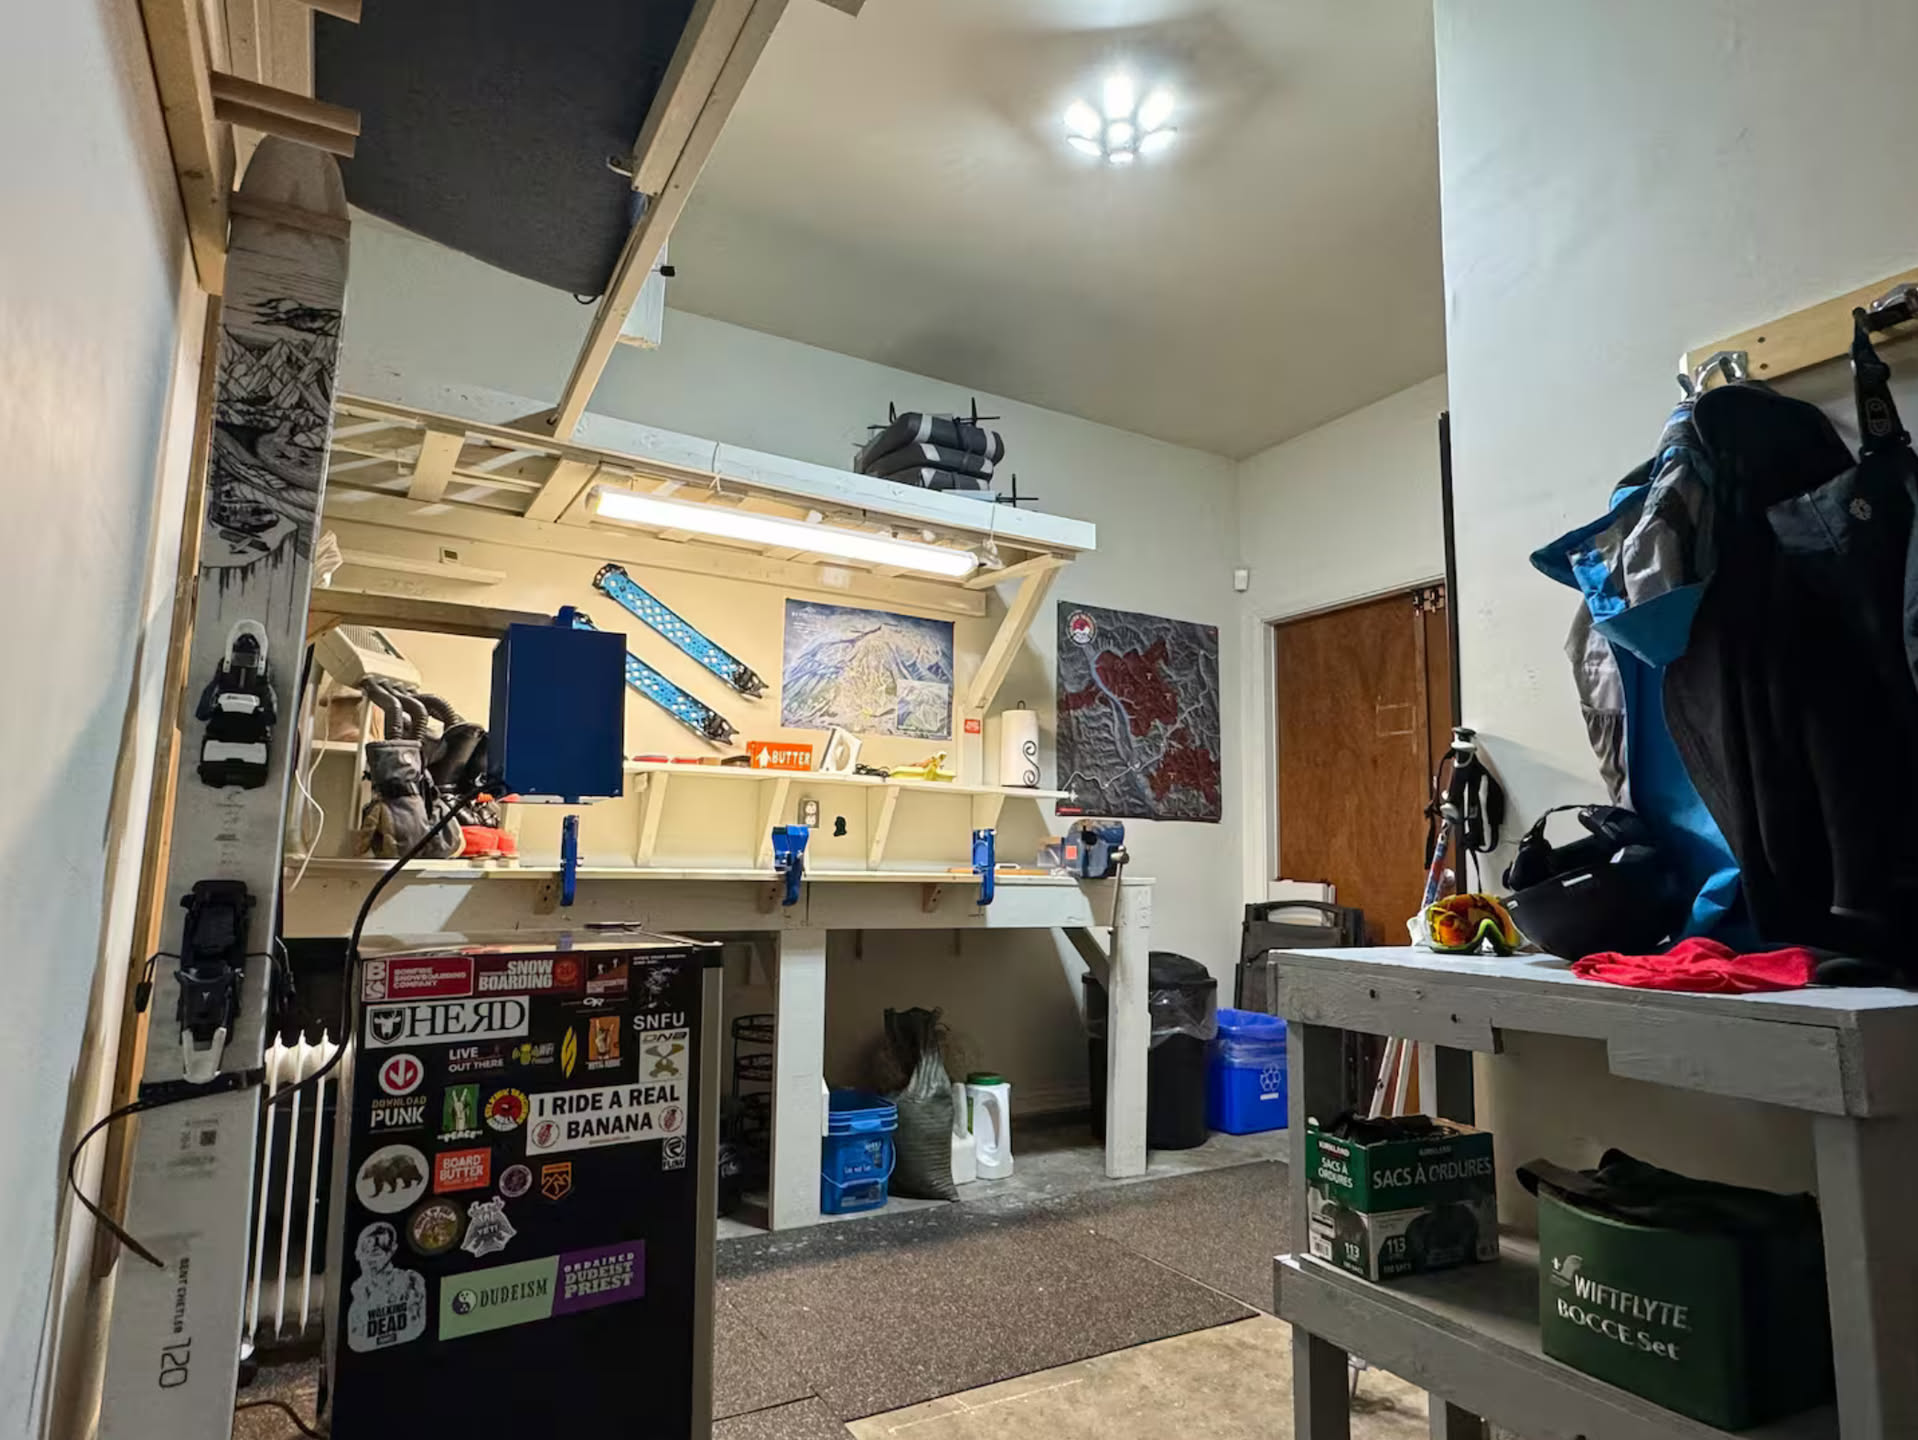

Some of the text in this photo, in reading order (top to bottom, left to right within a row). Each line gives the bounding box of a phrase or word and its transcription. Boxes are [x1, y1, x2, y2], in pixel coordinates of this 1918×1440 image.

[772, 750, 811, 766] BUTTER
[507, 960, 554, 975] SNOW
[393, 980, 438, 989] COMPANY
[478, 974, 553, 991] BOARDING
[633, 1011, 685, 1030] SNFU
[449, 1047, 479, 1061] LIVE
[448, 1059, 504, 1073] OUT THERE
[371, 1096, 427, 1109] DOWNLOAD
[539, 1098, 545, 1117] I
[552, 1092, 604, 1116] RIDE
[608, 1090, 622, 1109] A
[629, 1085, 680, 1107] REAL
[370, 1106, 424, 1128] PUNK
[567, 1112, 653, 1140] BANANA
[442, 1154, 482, 1169] BOARD
[1321, 1157, 1342, 1172] SACS
[439, 1166, 484, 1181] BUTTER
[1318, 1167, 1353, 1189] ORDURES
[1373, 1157, 1492, 1189] SACS À ORDURES
[1345, 1241, 1360, 1259] 113
[1386, 1237, 1406, 1253] 113
[178, 1257, 190, 1287] BENT
[564, 1252, 634, 1273] ORDAINED
[565, 1261, 634, 1285] DUDEIST
[480, 1277, 549, 1308] DUDEISM
[564, 1272, 634, 1299] PRIEST
[368, 1302, 407, 1320] WALKING
[367, 1313, 407, 1338] DEAD
[1557, 1297, 1680, 1360] BOCCE Set
[159, 1337, 191, 1388] 120
